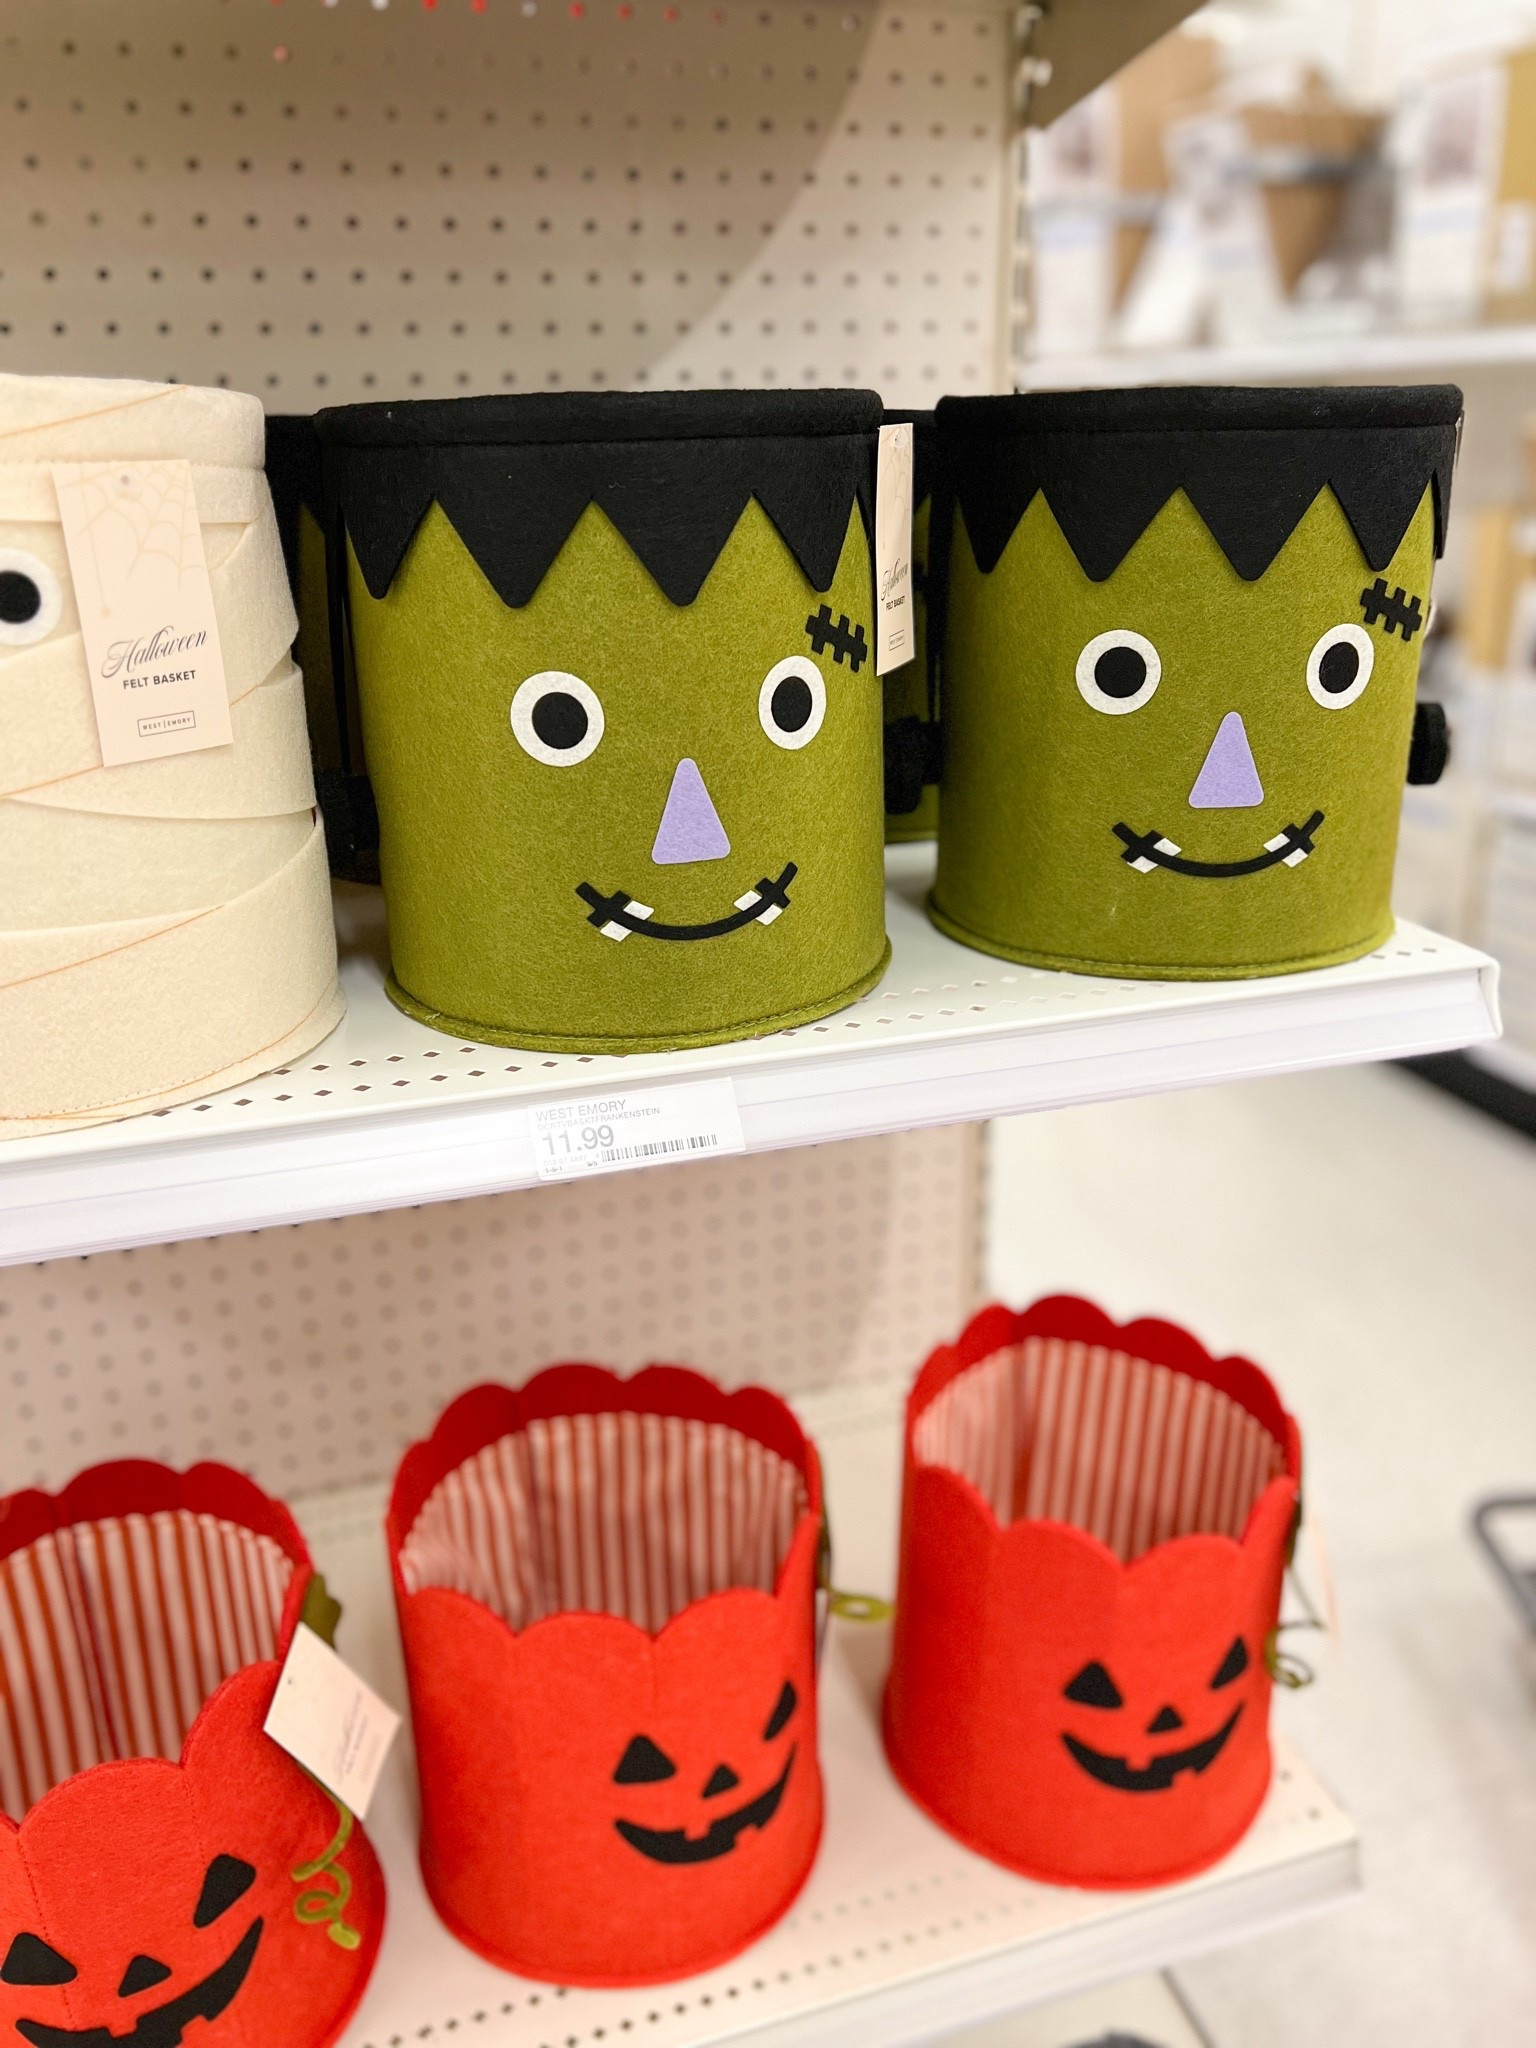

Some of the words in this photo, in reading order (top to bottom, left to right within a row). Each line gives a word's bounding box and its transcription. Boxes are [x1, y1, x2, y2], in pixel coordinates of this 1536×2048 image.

[101, 625, 207, 679] Halloween
[122, 676, 149, 690] FELT
[153, 669, 196, 686] BASKET
[142, 721, 161, 731] WEST
[167, 716, 192, 727] EMORY
[535, 1107, 575, 1122] WEST
[578, 1099, 626, 1117] EMORY
[542, 1124, 615, 1156] 11.99
